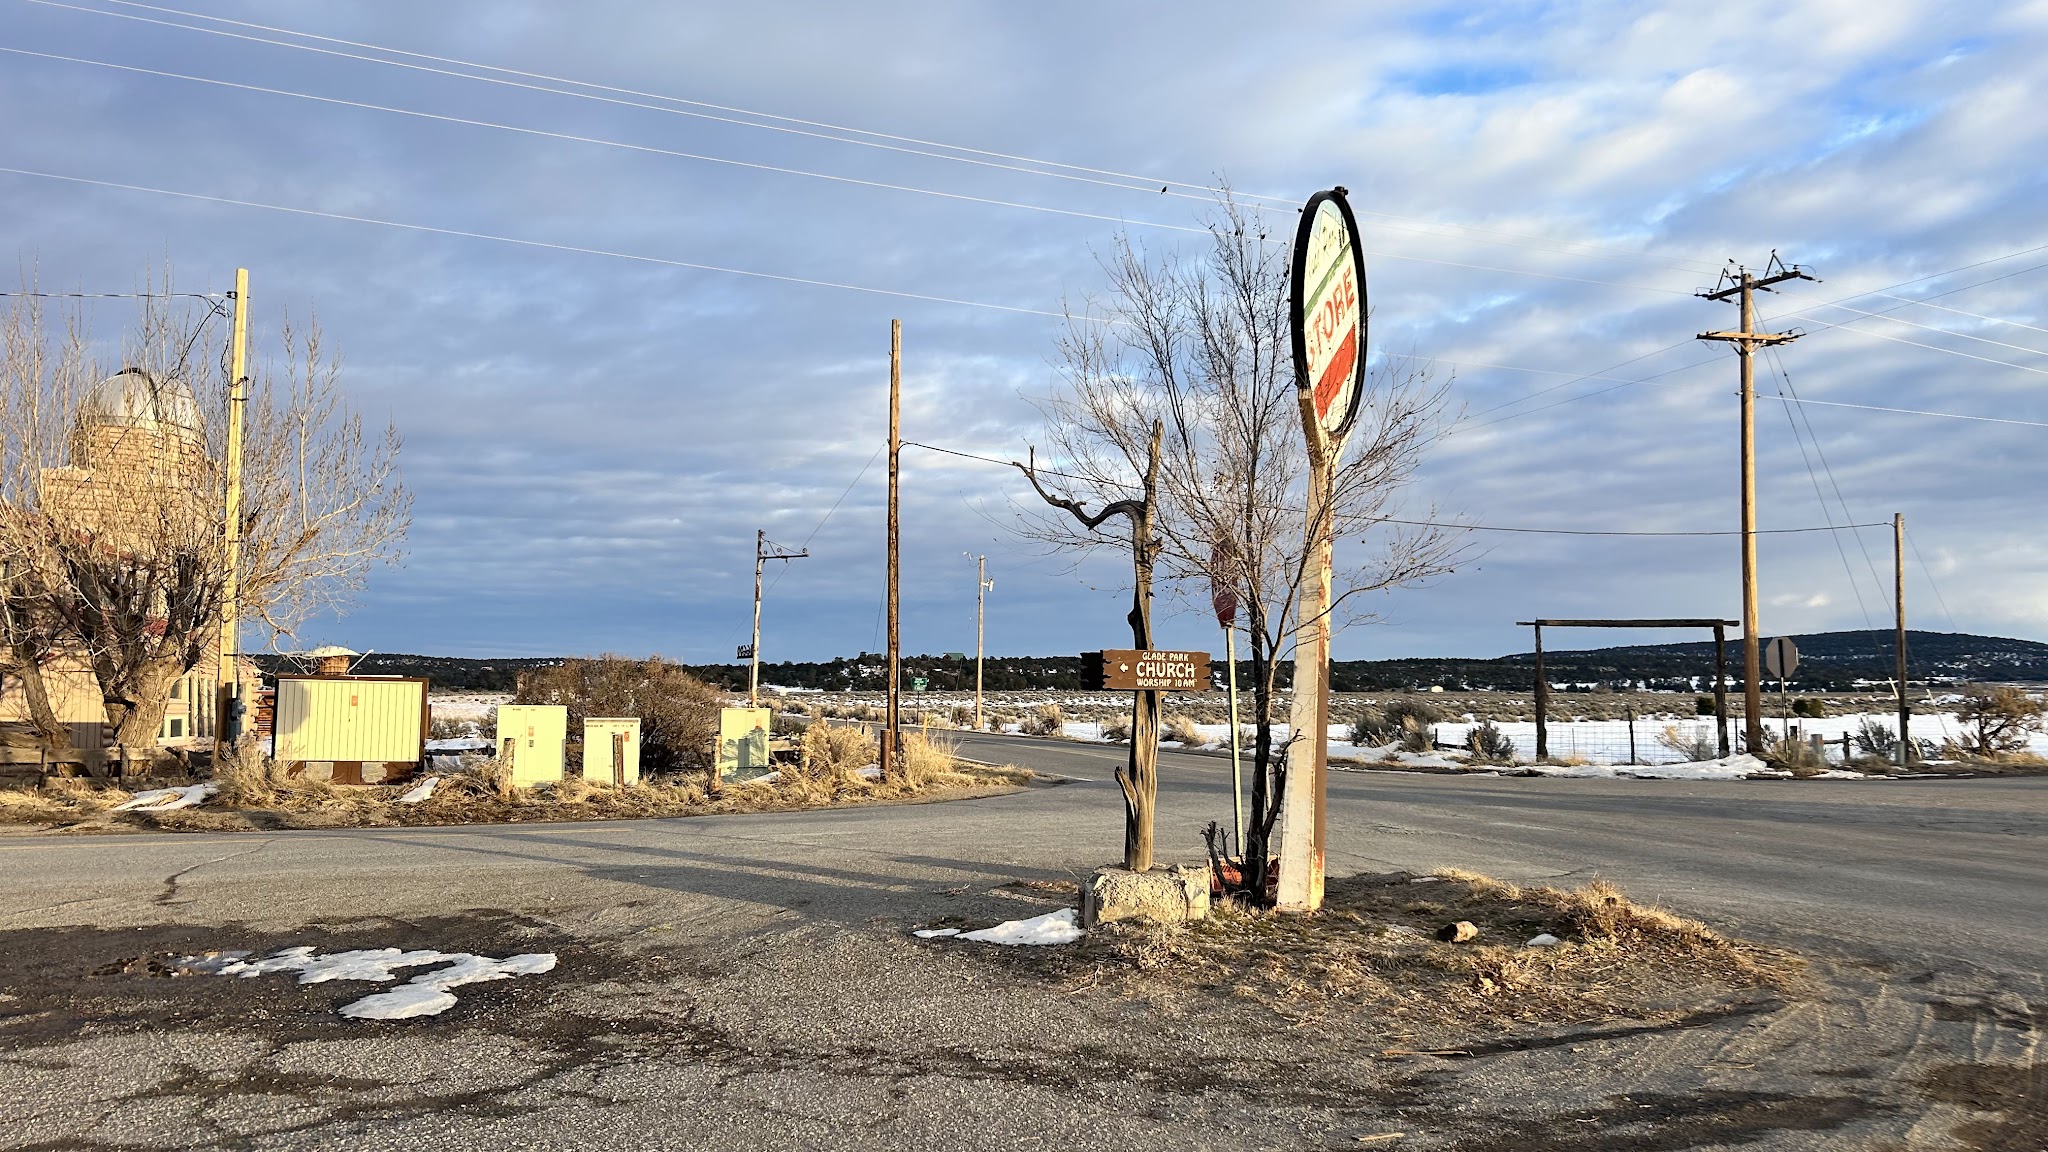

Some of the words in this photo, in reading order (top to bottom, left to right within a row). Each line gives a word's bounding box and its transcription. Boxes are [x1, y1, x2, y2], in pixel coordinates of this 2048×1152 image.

[1142, 652, 1166, 661] GLADE
[1169, 653, 1189, 662] PARK
[1136, 661, 1195, 678] CHURCH
[1136, 678, 1172, 687] WORSHIP
